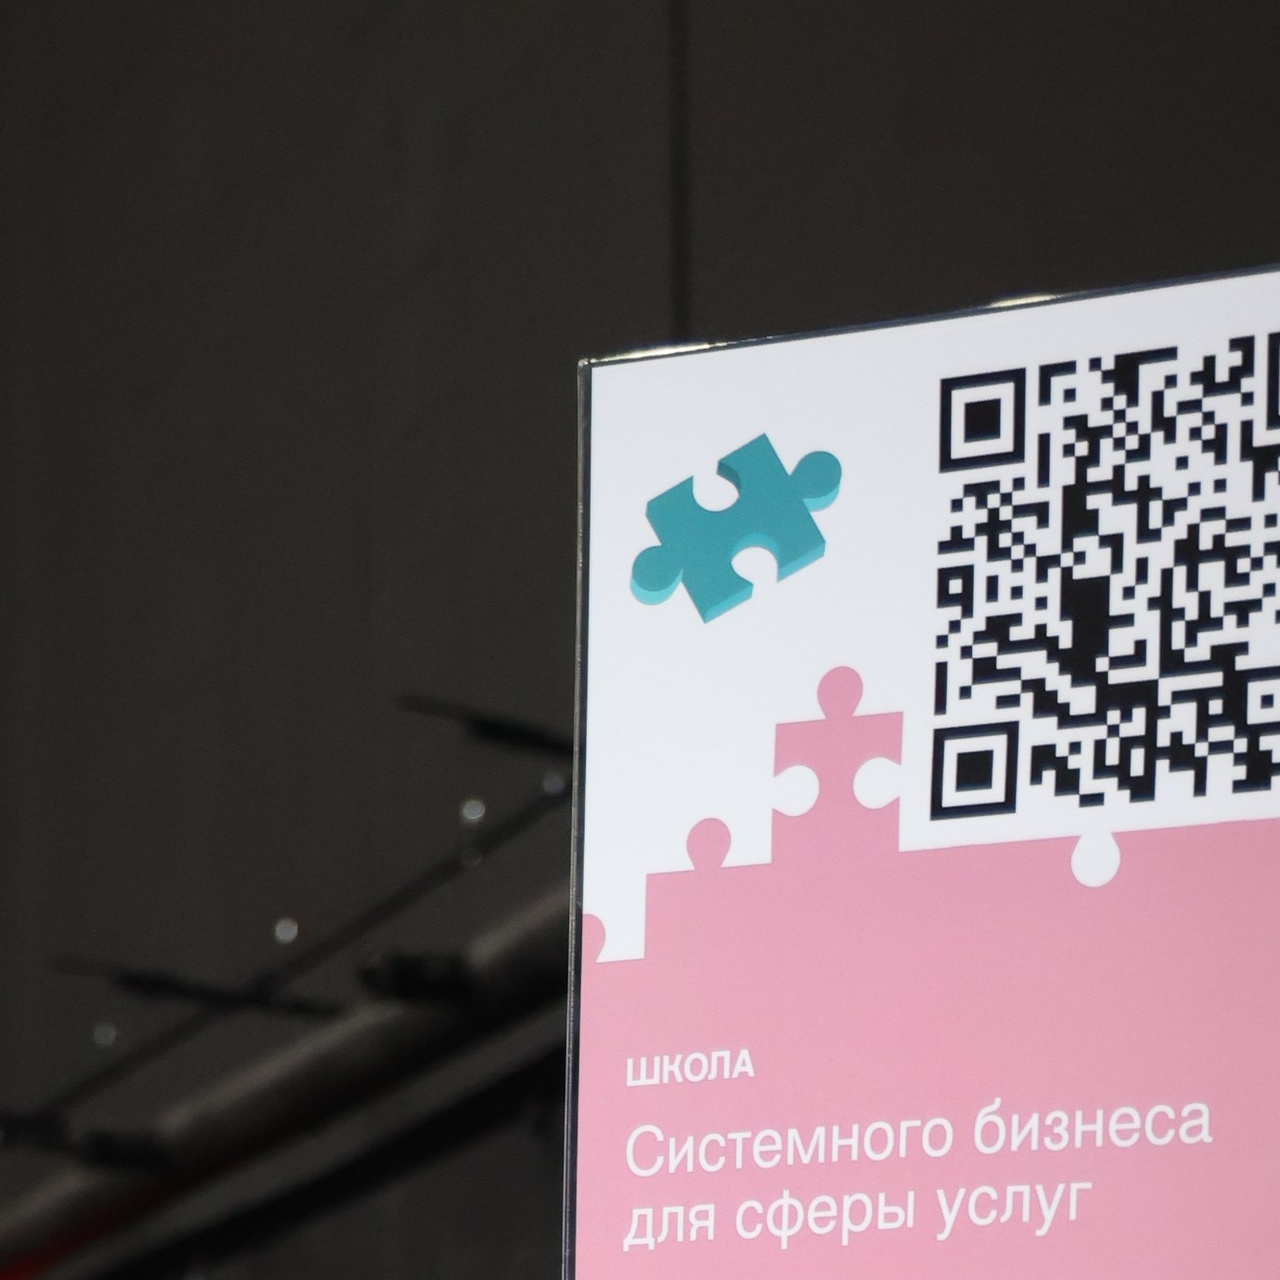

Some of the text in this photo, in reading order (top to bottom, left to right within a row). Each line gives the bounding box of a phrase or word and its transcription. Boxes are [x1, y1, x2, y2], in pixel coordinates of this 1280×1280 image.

[626, 1048, 755, 1087] ШКОЛА
[625, 1096, 1213, 1178] Системного бизнеса
[622, 1181, 1094, 1252] для сферы услуг
